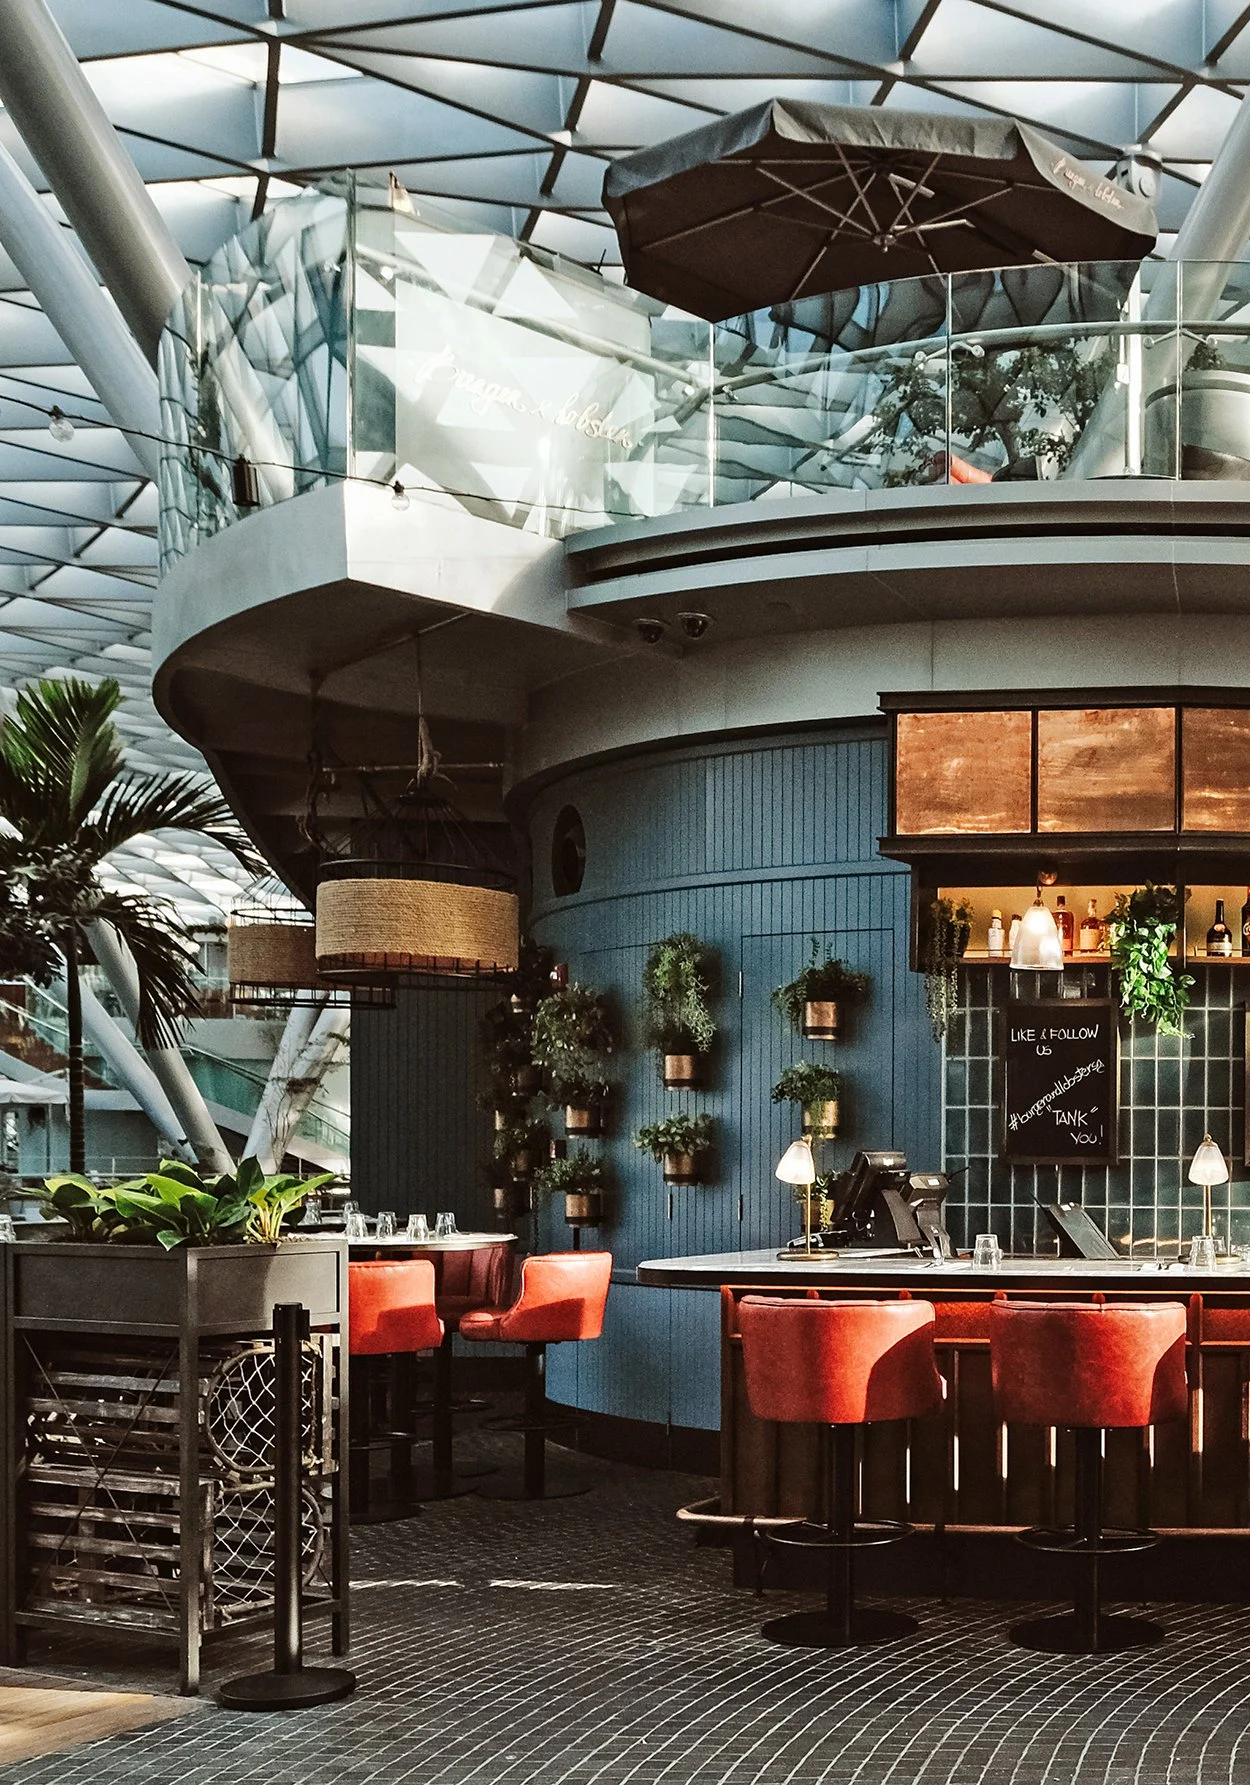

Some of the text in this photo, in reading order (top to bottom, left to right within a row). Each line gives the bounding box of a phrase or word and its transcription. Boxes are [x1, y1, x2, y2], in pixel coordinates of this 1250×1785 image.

[1011, 1028, 1036, 1042] LIKE
[1050, 1024, 1099, 1040] FOLLOW
[1036, 1044, 1052, 1056] US
